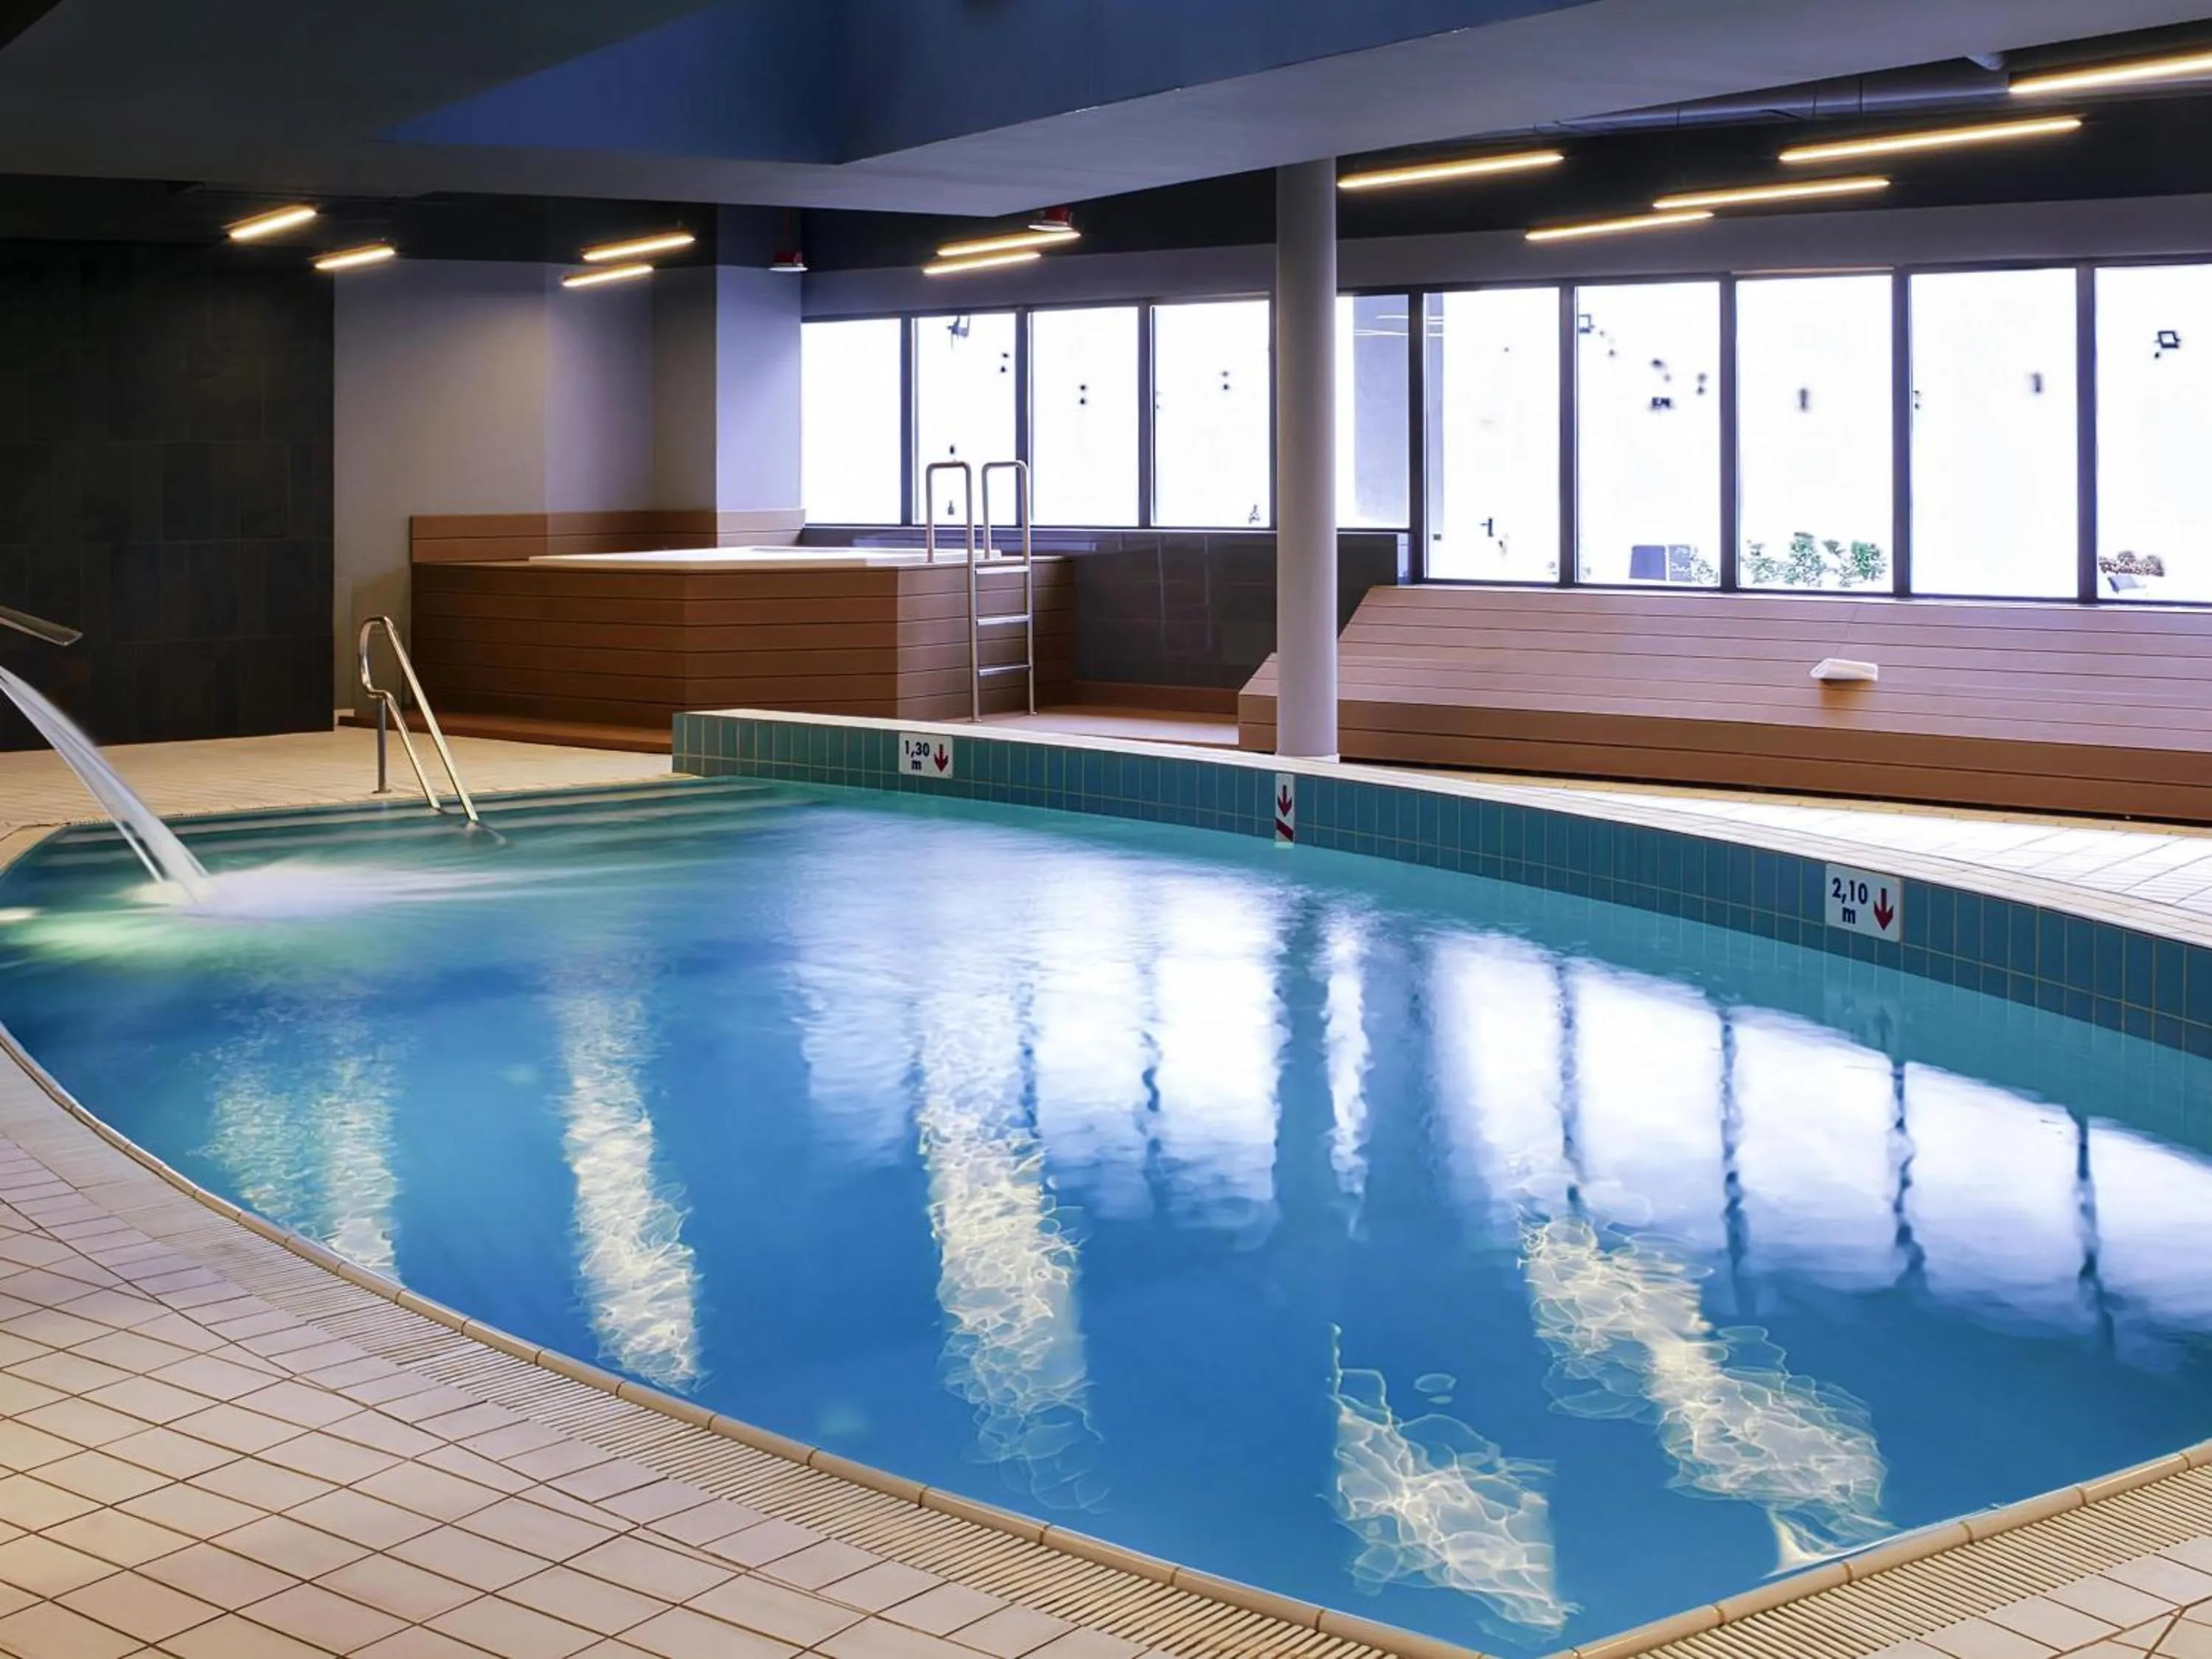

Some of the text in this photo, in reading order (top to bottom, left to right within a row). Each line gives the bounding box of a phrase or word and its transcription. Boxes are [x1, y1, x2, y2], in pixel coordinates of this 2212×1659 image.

[905, 740, 930, 758] 1,30
[911, 760, 922, 771] m
[1832, 877, 1868, 905] 2,10
[1842, 906, 1856, 925] m
